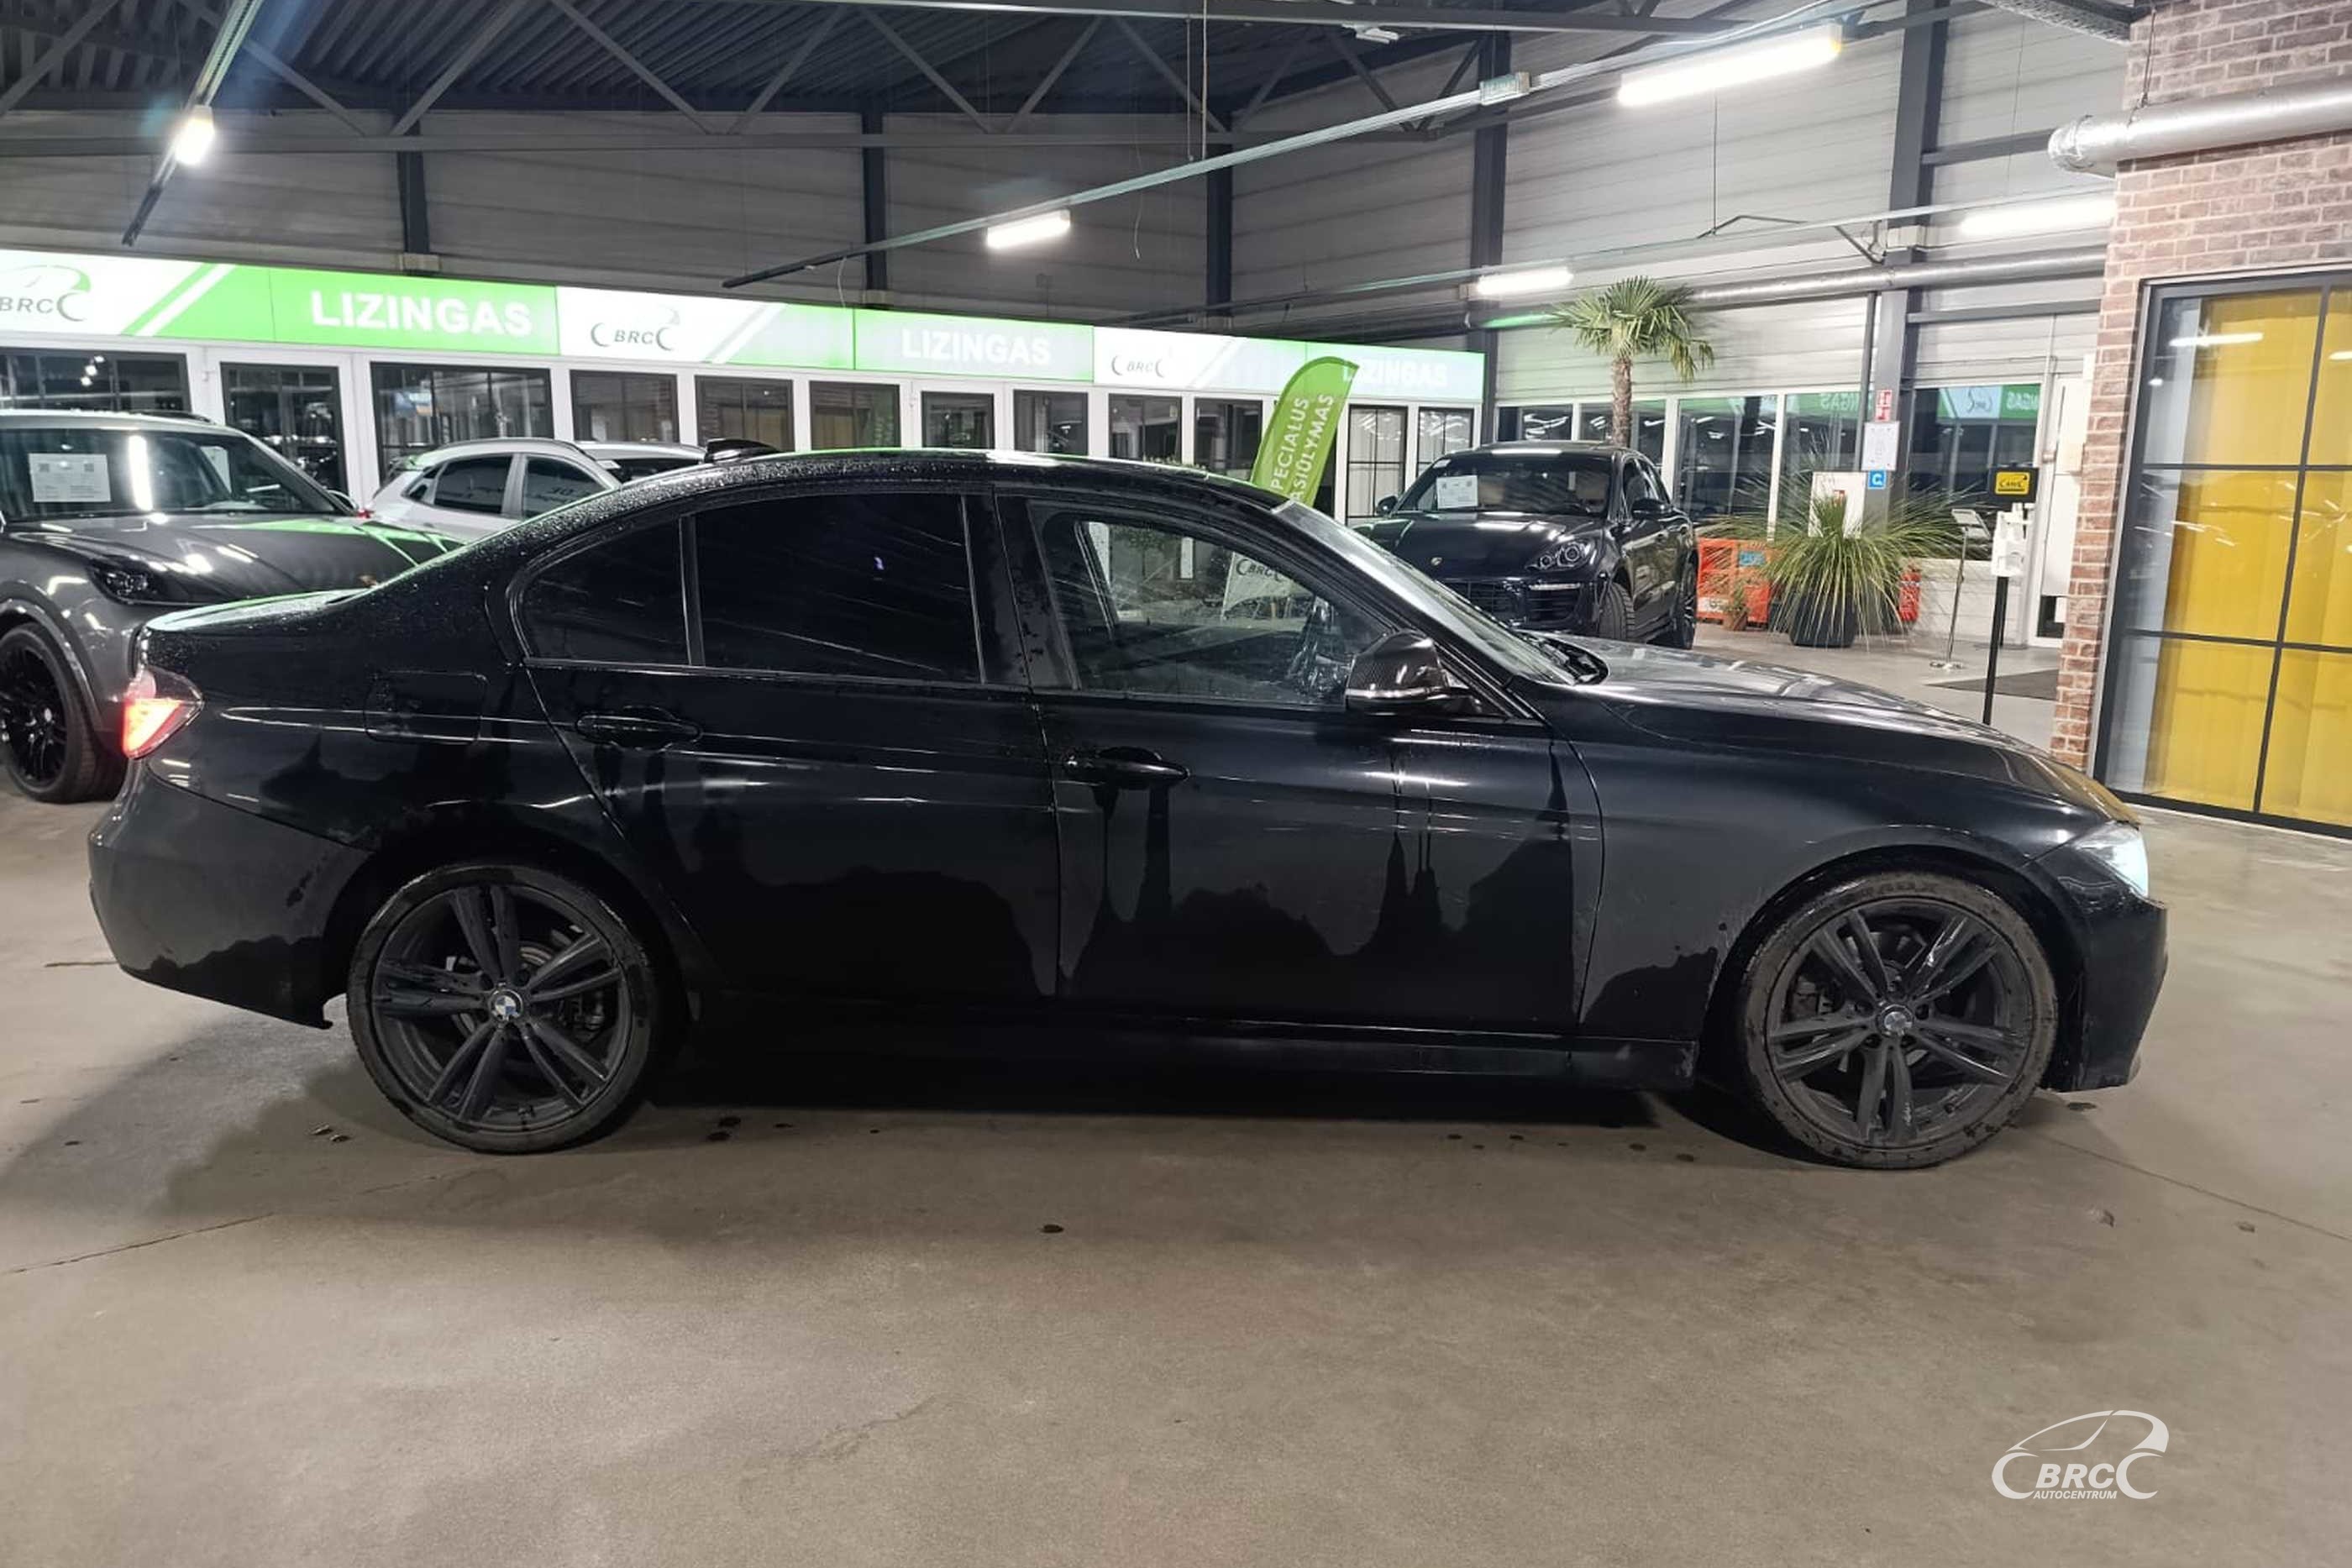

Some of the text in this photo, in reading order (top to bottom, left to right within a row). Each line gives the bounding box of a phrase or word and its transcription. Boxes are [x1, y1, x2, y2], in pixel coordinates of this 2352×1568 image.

[310, 290, 534, 337] LIZINGAS
[901, 328, 1051, 366] LIZINGAS
[1270, 398, 1310, 490] PECIALUS
[1290, 394, 1334, 501] ASIŪLYMAS
